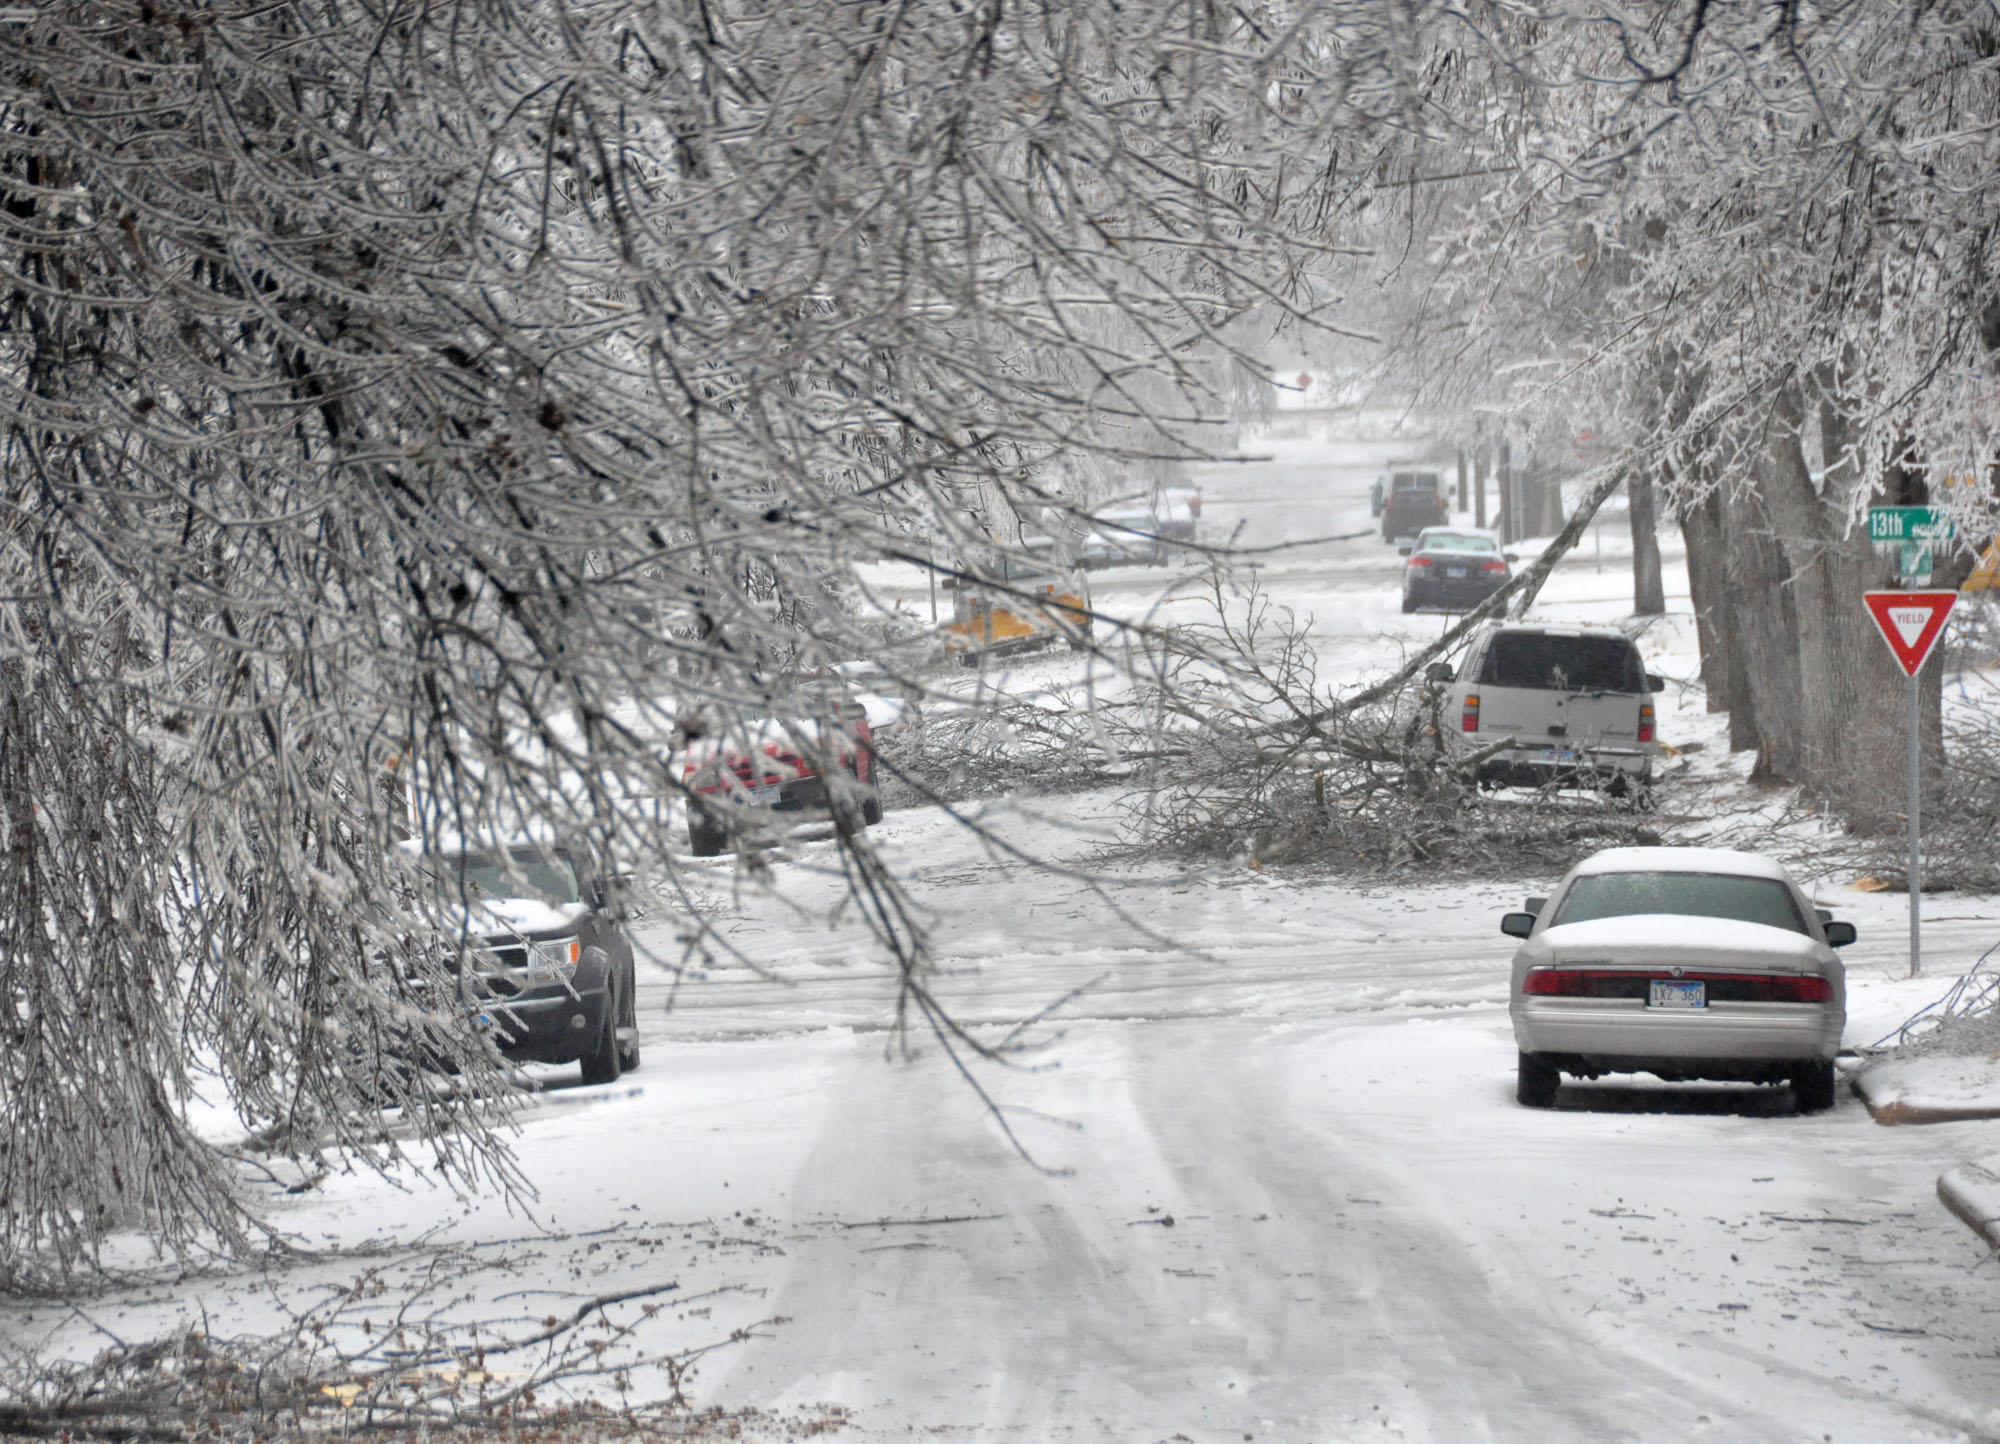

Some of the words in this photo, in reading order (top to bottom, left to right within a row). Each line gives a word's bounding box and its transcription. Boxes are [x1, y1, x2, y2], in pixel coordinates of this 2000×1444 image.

[1871, 512, 1903, 536] 13th
[1896, 613, 1925, 624] YIELD
[1681, 988, 1702, 1001] 360
